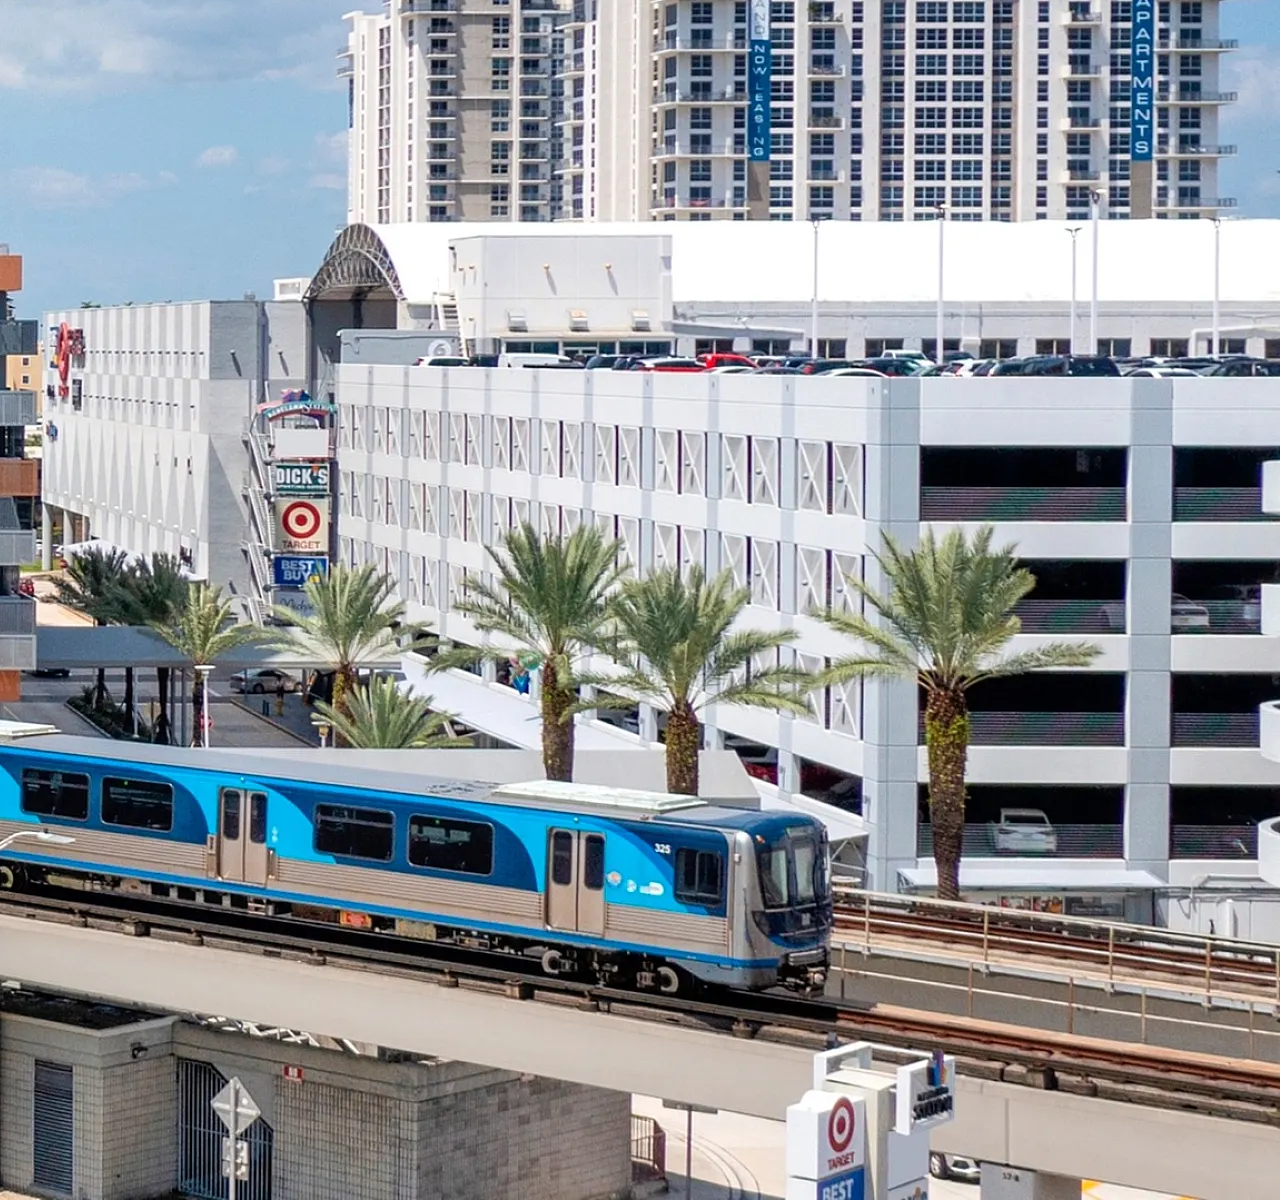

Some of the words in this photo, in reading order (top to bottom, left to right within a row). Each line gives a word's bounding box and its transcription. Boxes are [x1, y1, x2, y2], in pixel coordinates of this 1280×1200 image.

[752, 44, 767, 75] NOW
[753, 82, 766, 157] LEASING
[276, 467, 328, 485] DICK'S
[282, 541, 320, 549] TARGET
[281, 560, 314, 570] BEST
[284, 571, 310, 581] BUY
[654, 843, 671, 854] 325
[827, 1152, 855, 1170] TARGET
[822, 1178, 854, 1200] BEST
